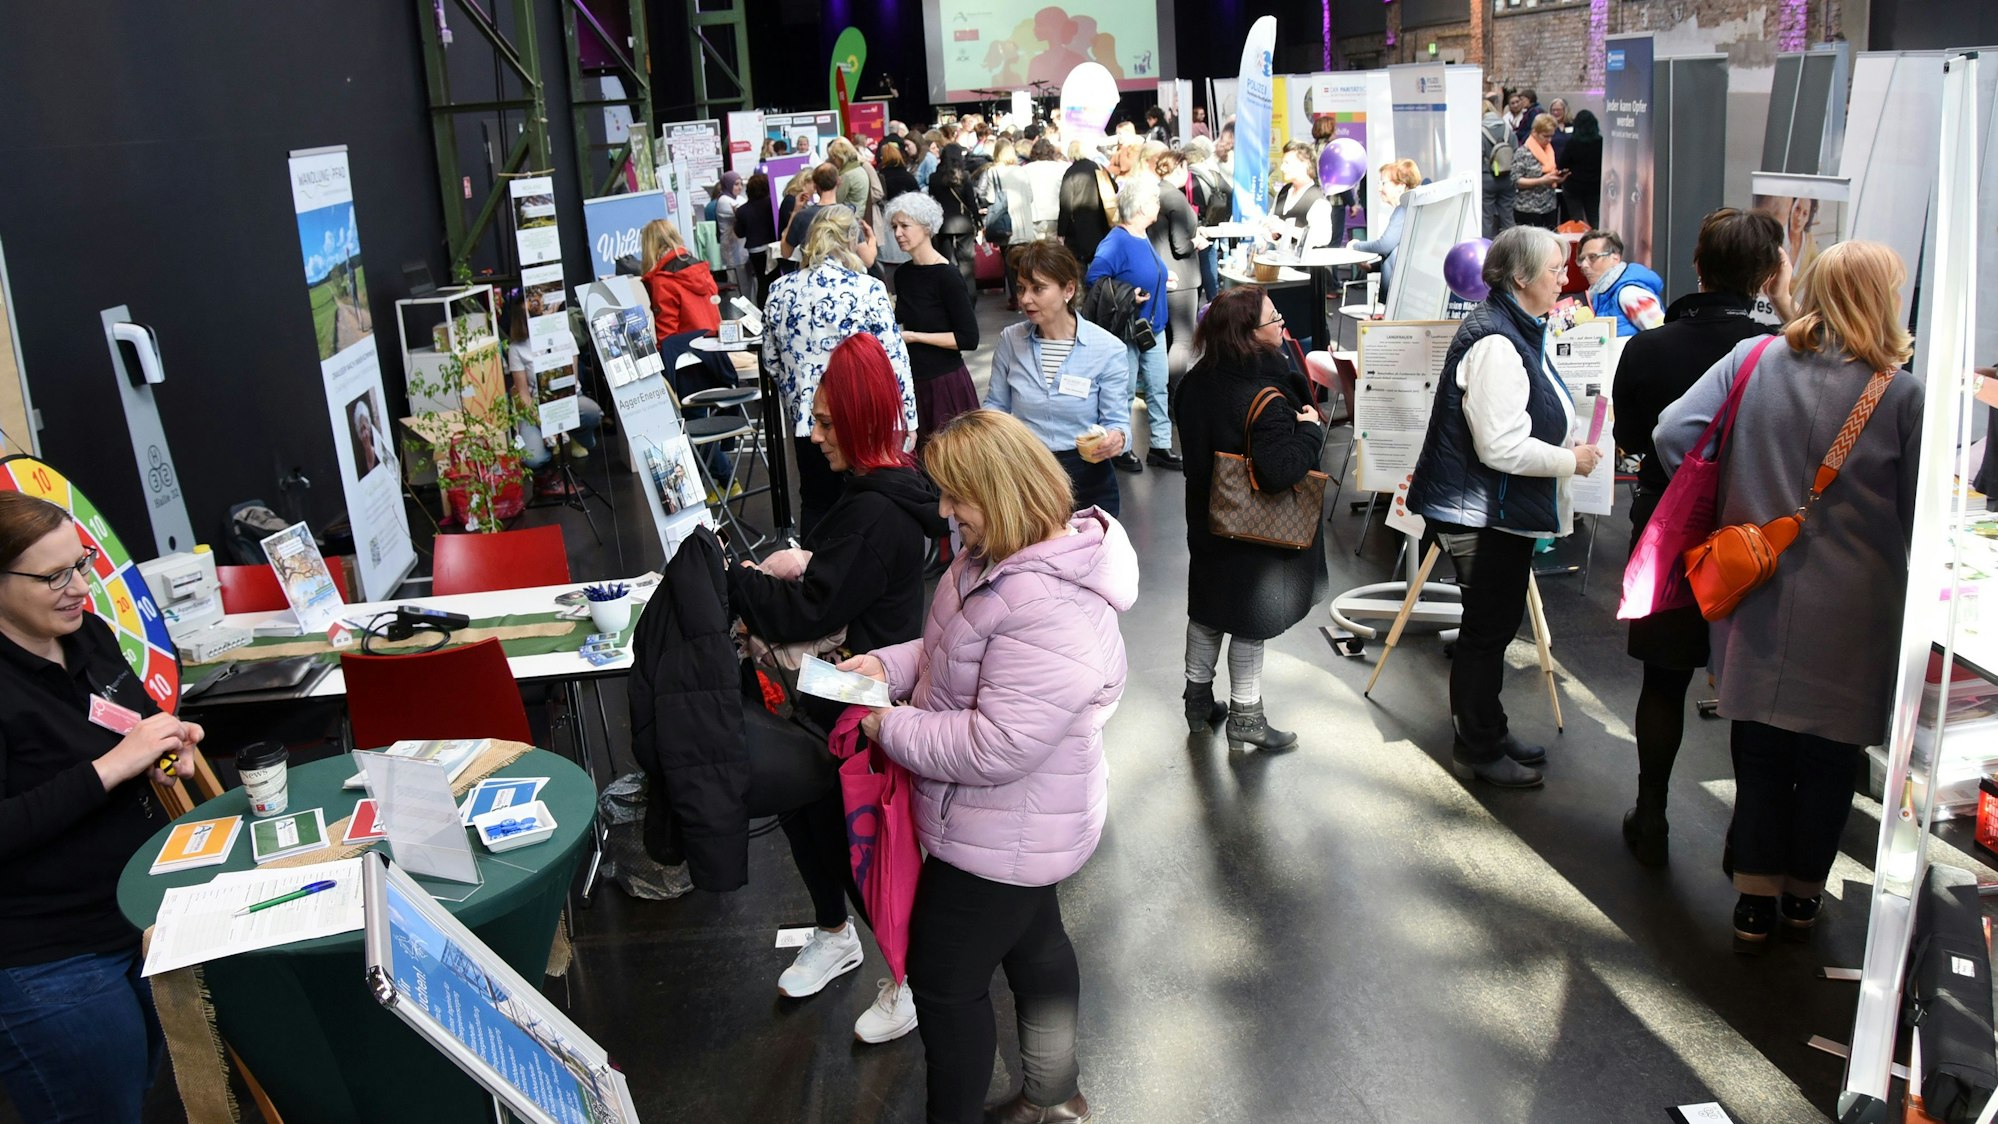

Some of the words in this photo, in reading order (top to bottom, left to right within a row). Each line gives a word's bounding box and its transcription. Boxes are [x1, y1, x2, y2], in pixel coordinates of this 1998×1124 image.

[1247, 79, 1268, 95] POLIZEI
[1606, 99, 1619, 113] Jeder
[1620, 100, 1631, 112] kann
[1632, 100, 1647, 115] Opfer
[1617, 115, 1635, 127] werden
[619, 387, 667, 410] AggerEnergie
[32, 467, 52, 494] 10
[154, 495, 170, 509] Halle
[171, 488, 179, 499] 32
[89, 515, 108, 541] 10
[116, 596, 131, 613] 20
[137, 595, 158, 622] 10
[149, 673, 173, 701] 10
[241, 769, 268, 780] News
[412, 964, 430, 1012] uchen!
